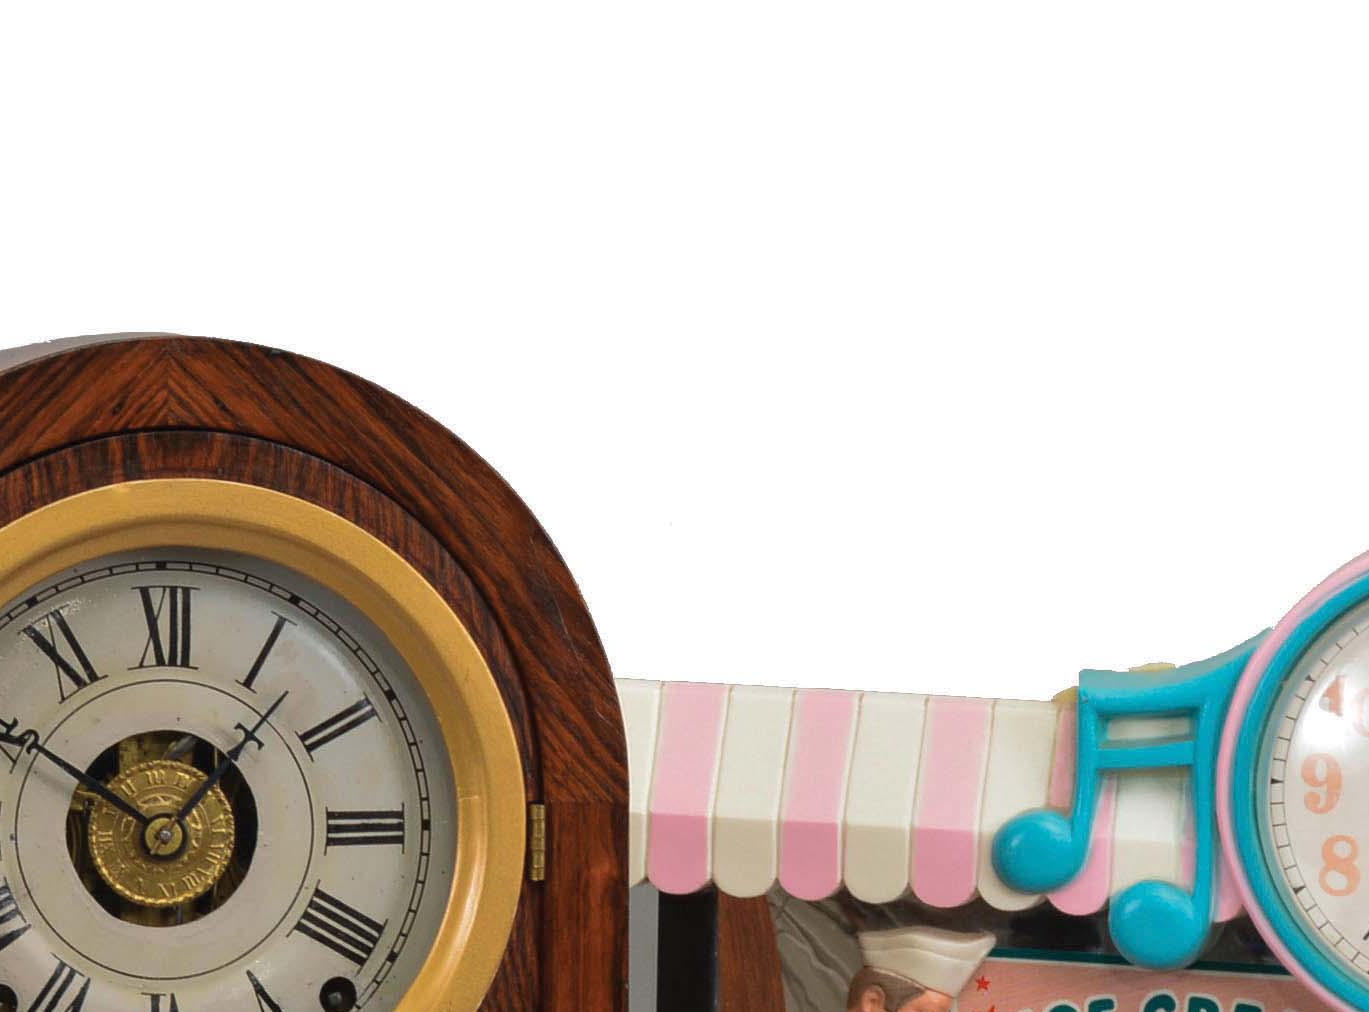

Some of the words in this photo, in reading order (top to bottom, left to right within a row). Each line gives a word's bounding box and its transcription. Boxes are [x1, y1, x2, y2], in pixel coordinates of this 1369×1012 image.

[20, 608, 107, 703] XI
[128, 586, 200, 670] XII
[236, 612, 297, 693] I
[297, 694, 382, 761] II
[1301, 753, 1343, 814] 9
[325, 803, 405, 855] III
[1318, 835, 1360, 896] 8
[288, 880, 388, 974] IIII
